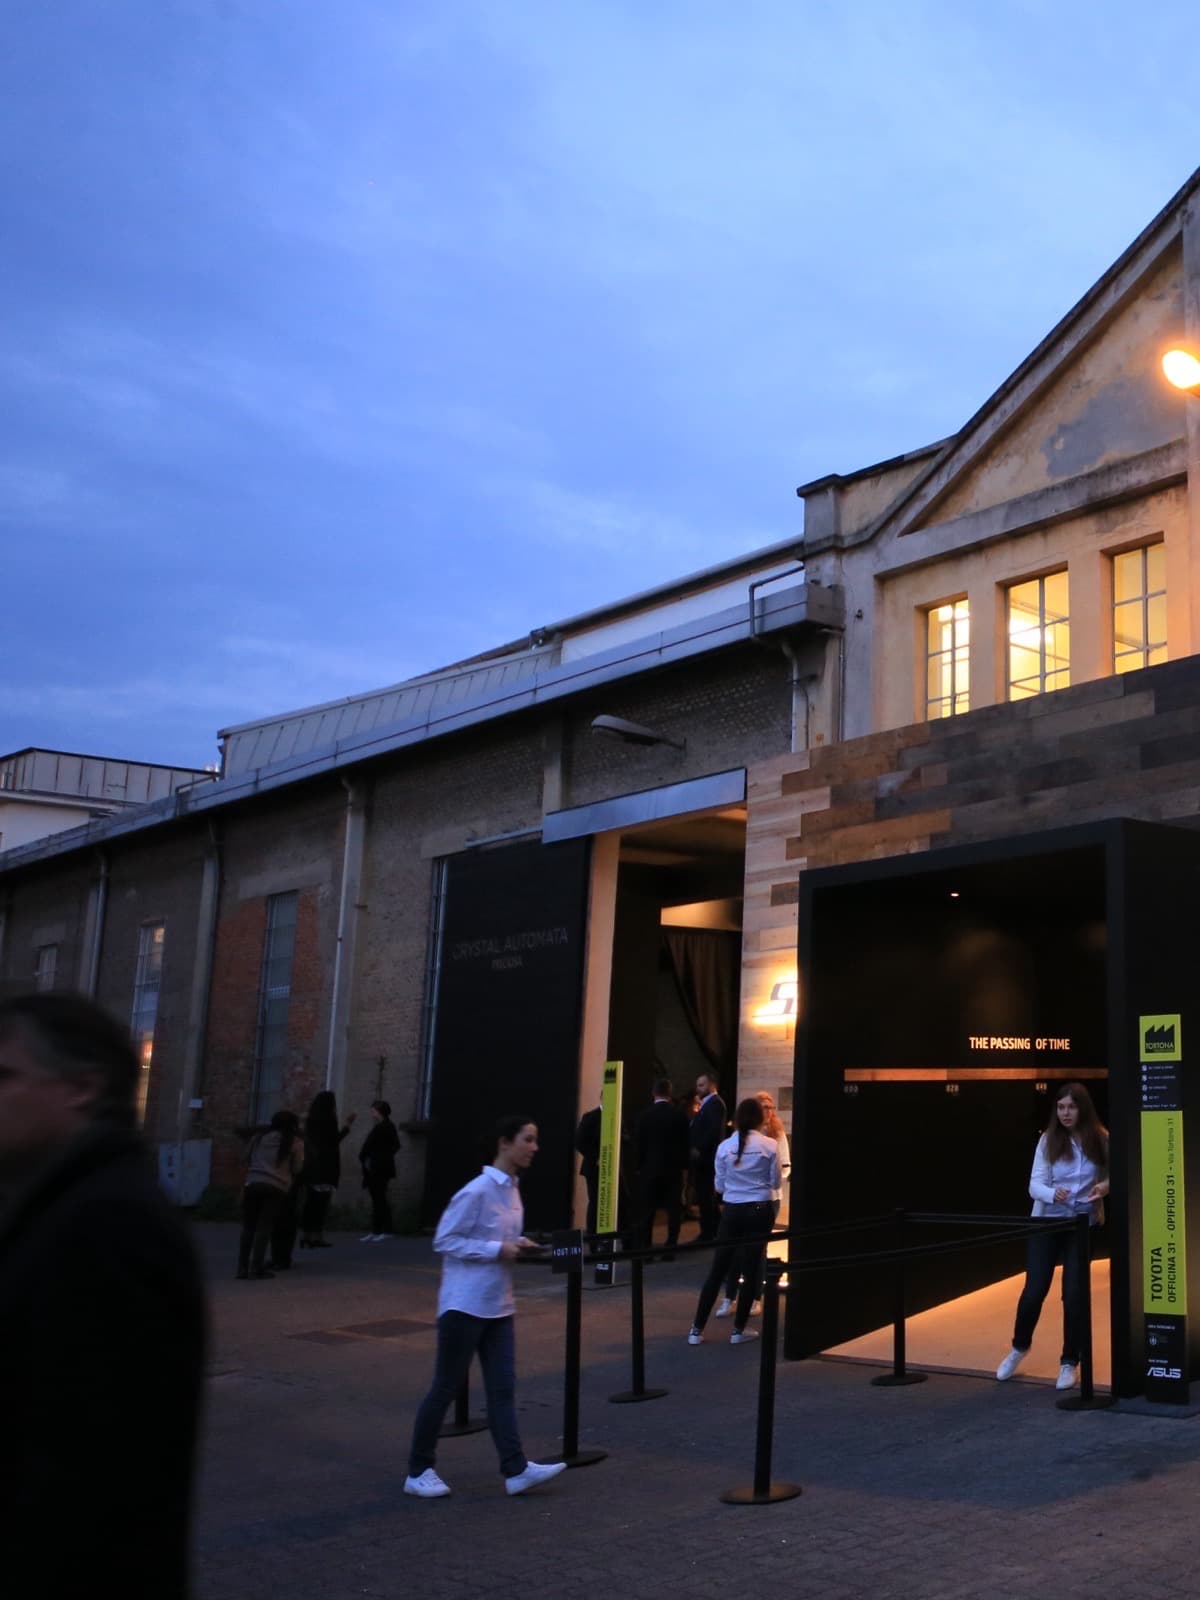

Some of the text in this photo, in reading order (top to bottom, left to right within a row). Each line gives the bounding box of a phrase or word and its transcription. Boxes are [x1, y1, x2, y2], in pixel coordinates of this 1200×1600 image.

[452, 928, 568, 960] CRYSTAL AUTOMATA
[969, 1037, 1071, 1050] THE PASSING OF TIME
[1145, 1041, 1174, 1049] TORTONA
[1167, 1152, 1175, 1165] Via
[1166, 1174, 1176, 1186] 31
[1166, 1188, 1176, 1231] OPIFICIO
[1167, 1242, 1176, 1254] 31
[1151, 1246, 1163, 1302] TOYOTA
[1167, 1256, 1177, 1303] OFFICINA
[1147, 1366, 1181, 1379] ASUS
